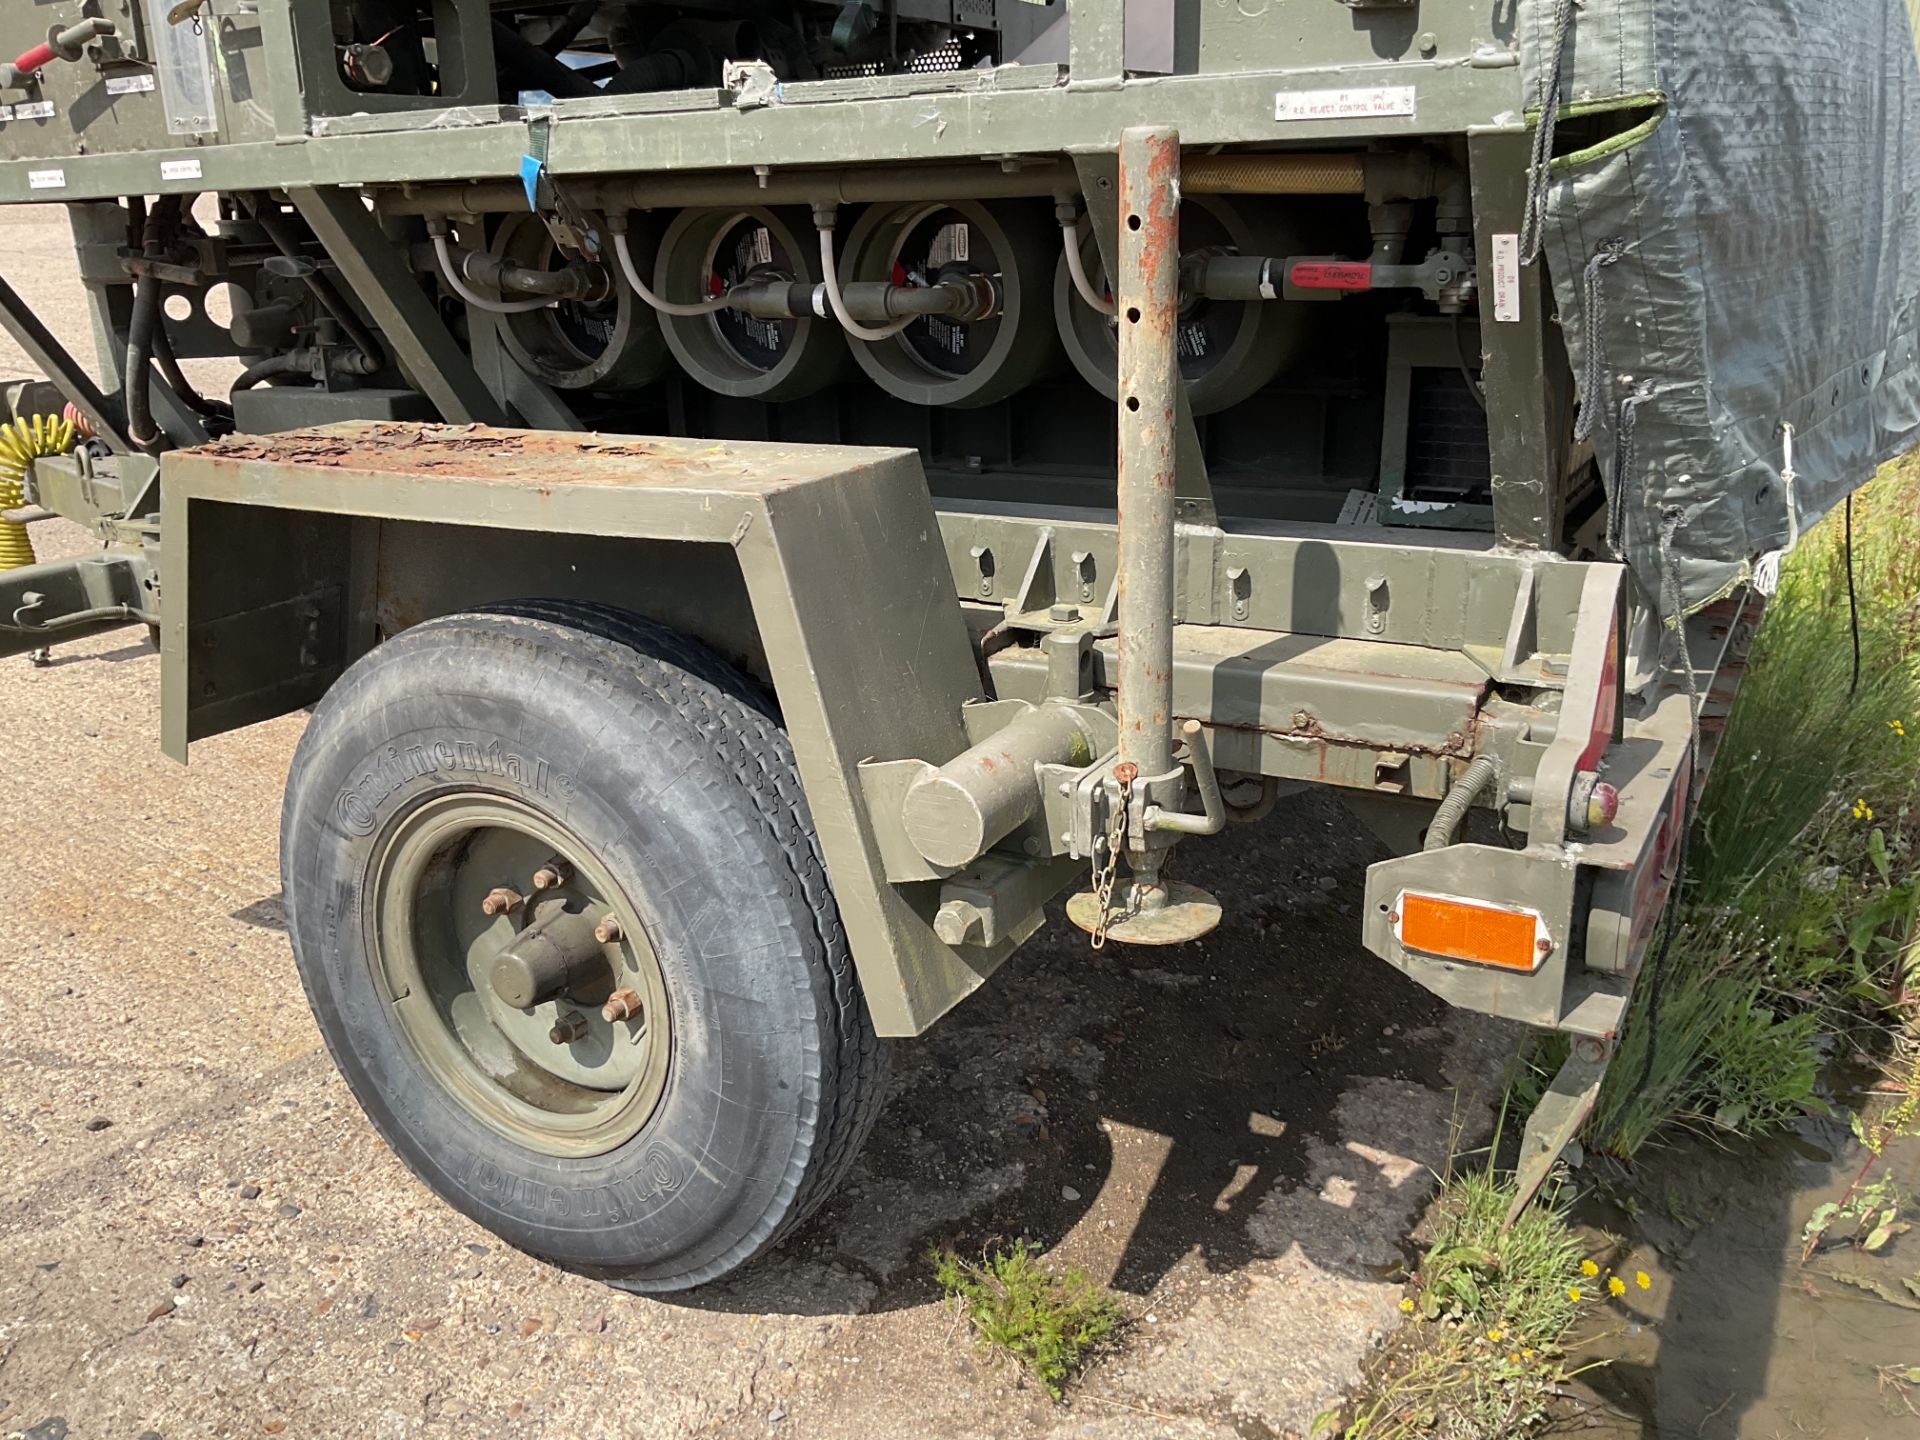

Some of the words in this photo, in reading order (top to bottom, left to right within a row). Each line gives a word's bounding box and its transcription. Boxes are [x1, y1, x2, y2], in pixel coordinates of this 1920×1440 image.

[1309, 104, 1334, 114] REJECT
[1339, 102, 1369, 113] CONTROL
[1373, 101, 1395, 111] VALVE
[1497, 264, 1505, 288] PRODUCT
[1497, 291, 1506, 308] DRAIN
